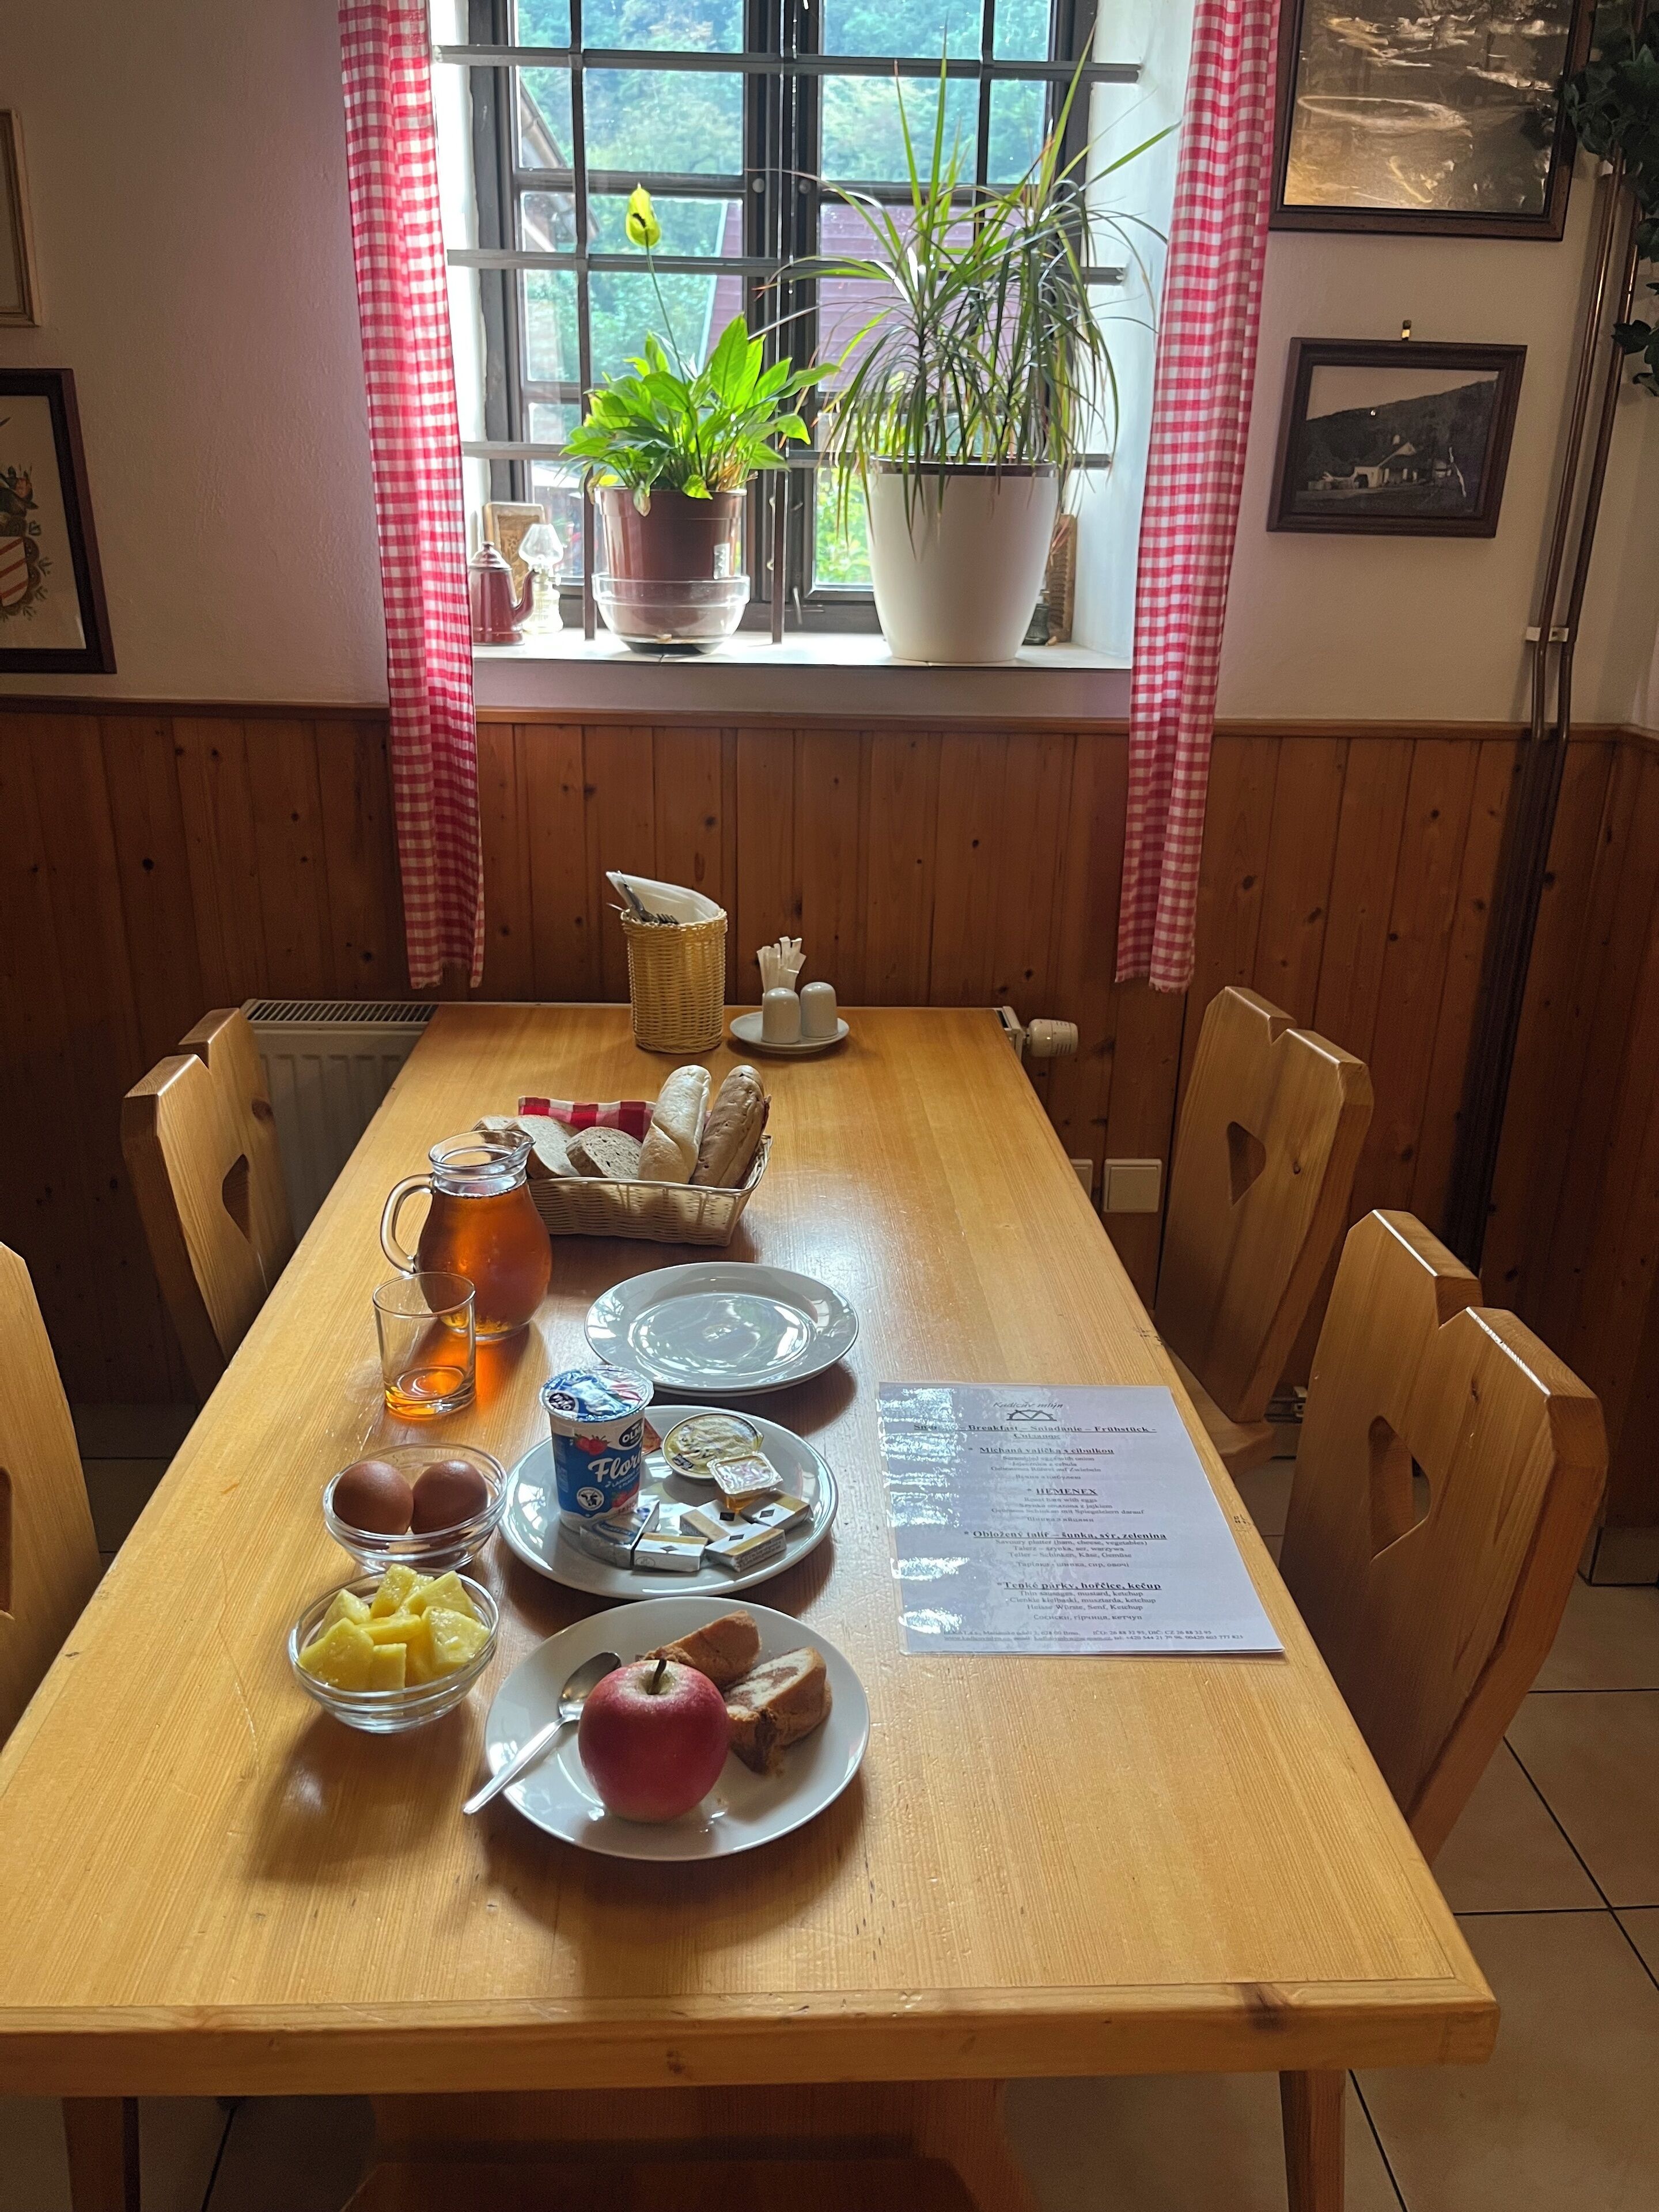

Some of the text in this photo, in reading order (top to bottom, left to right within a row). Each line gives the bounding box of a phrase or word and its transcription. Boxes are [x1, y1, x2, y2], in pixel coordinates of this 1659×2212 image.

[622, 1426, 642, 1443] OLM
[1062, 1531, 1098, 1539] šunka,
[1080, 1582, 1125, 1590] hořčice,
[1127, 1582, 1161, 1590] kečup
